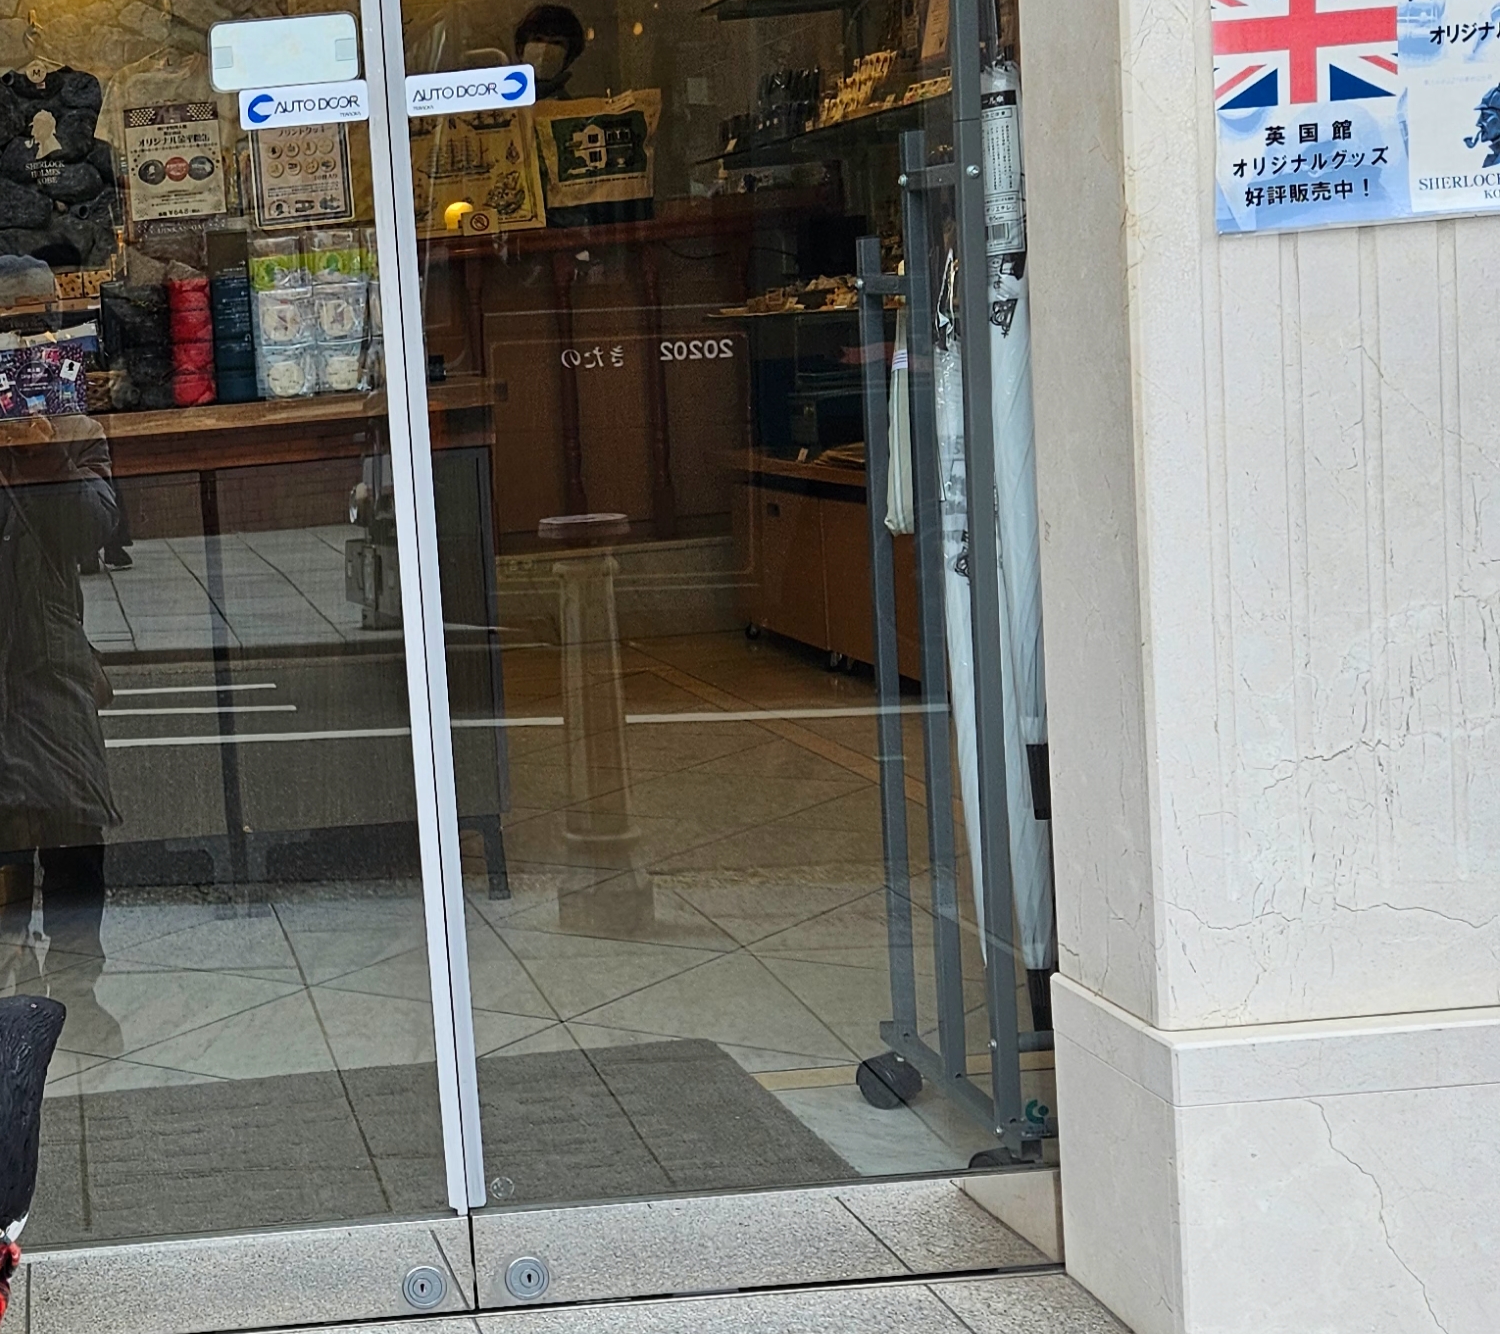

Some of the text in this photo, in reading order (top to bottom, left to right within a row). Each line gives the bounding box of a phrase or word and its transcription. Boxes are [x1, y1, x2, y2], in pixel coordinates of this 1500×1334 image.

[32, 69, 41, 77] M
[412, 82, 498, 103] AUTO DOOR
[274, 94, 360, 115] AUTO DOOR
[1265, 119, 1353, 146] 英国館
[25, 160, 65, 171] SHERLOCK
[1232, 146, 1389, 178] オリジナルグッズ
[1244, 177, 1372, 208] 好評販売中！
